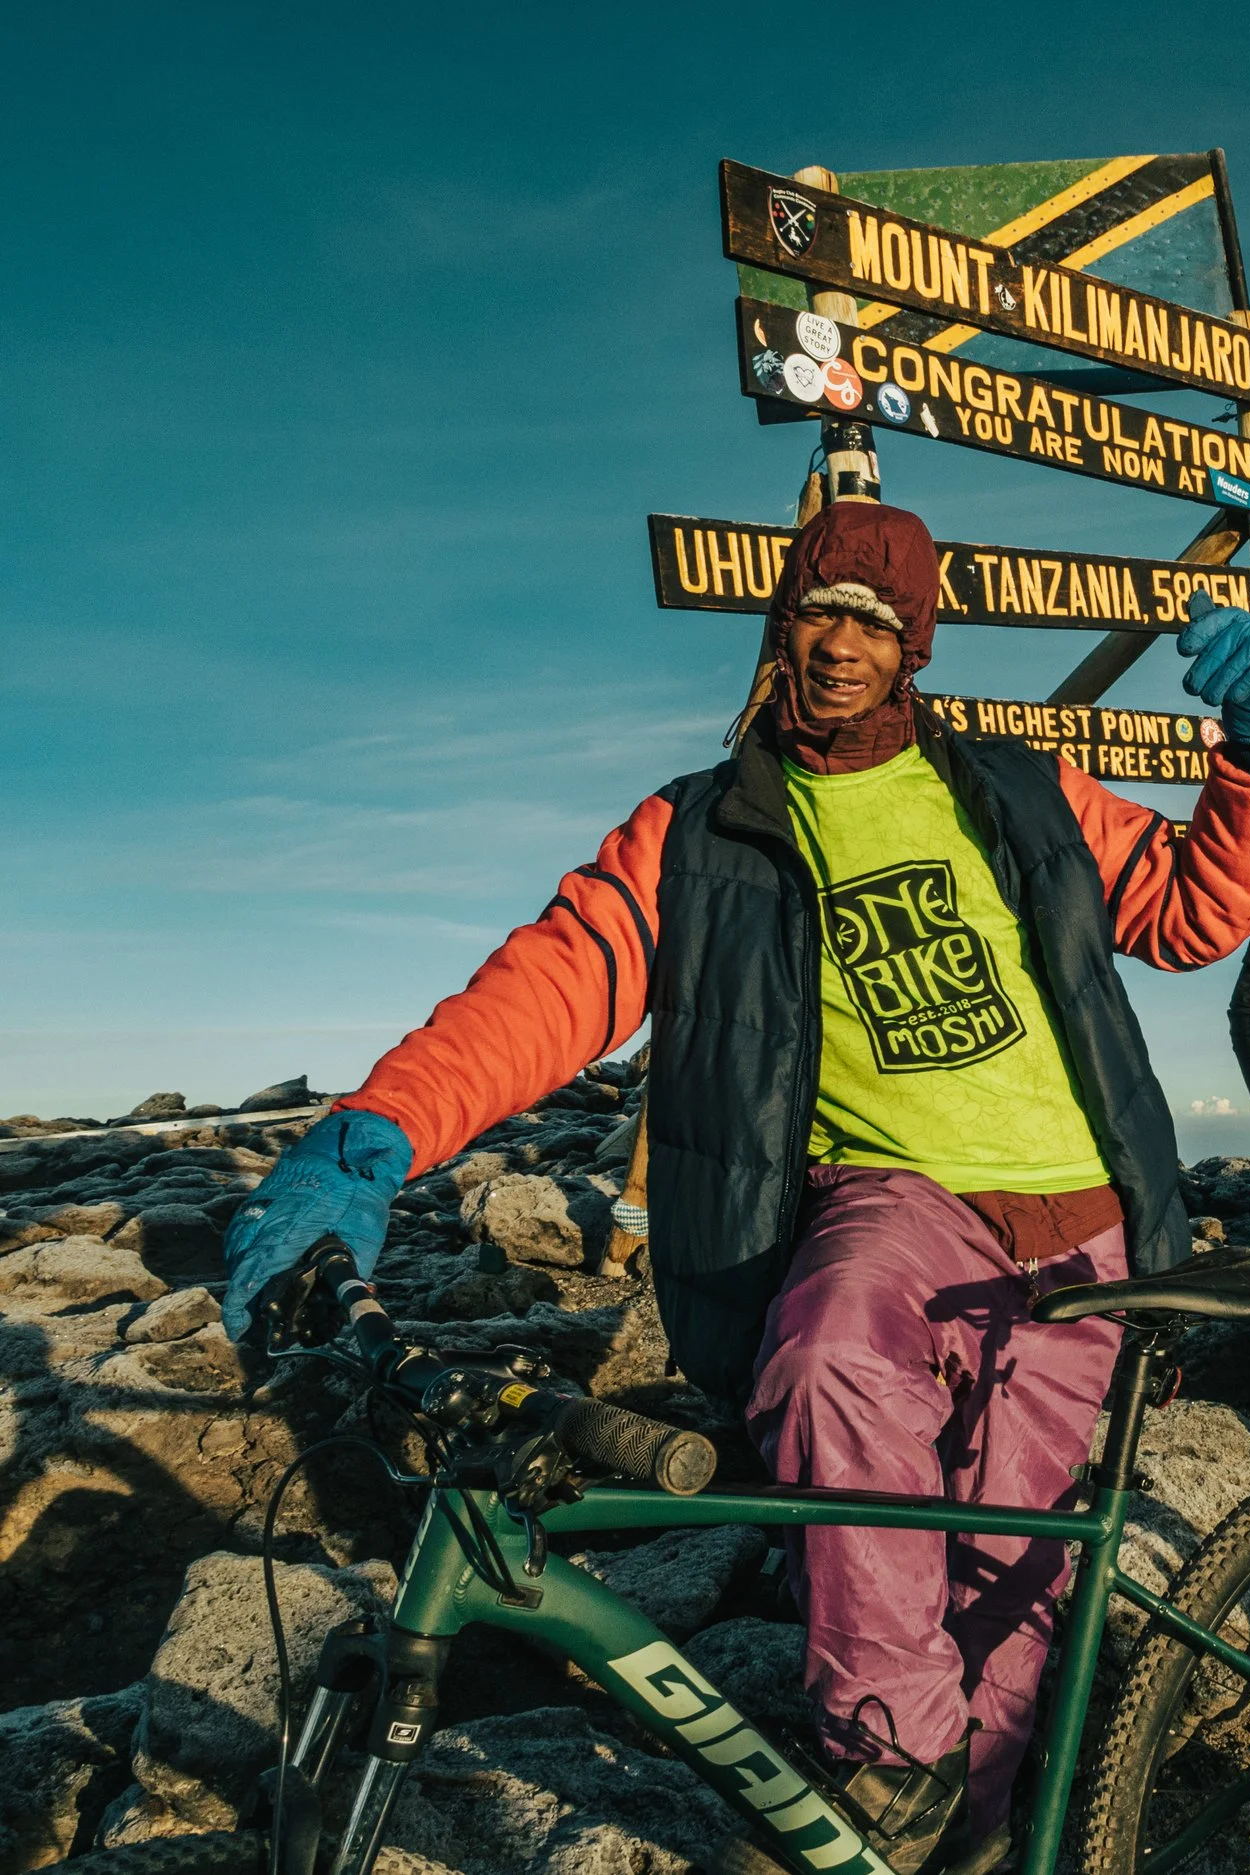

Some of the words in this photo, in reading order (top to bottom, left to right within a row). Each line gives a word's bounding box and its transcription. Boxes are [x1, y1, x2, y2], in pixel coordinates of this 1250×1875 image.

[849, 210, 995, 315] MOUNT
[805, 325, 832, 344] GREAT
[807, 315, 825, 330] LIVE
[804, 335, 830, 354] STORY
[954, 406, 1013, 445] YOU
[1029, 426, 1083, 464] ARE
[1102, 446, 1165, 486] NOW
[1178, 465, 1207, 495] AT
[1217, 476, 1249, 499] Nauders
[674, 528, 794, 598] UHU
[974, 553, 1149, 625] TANZANIA,
[977, 702, 1091, 739] HIGHEST
[1101, 709, 1171, 745] POINT
